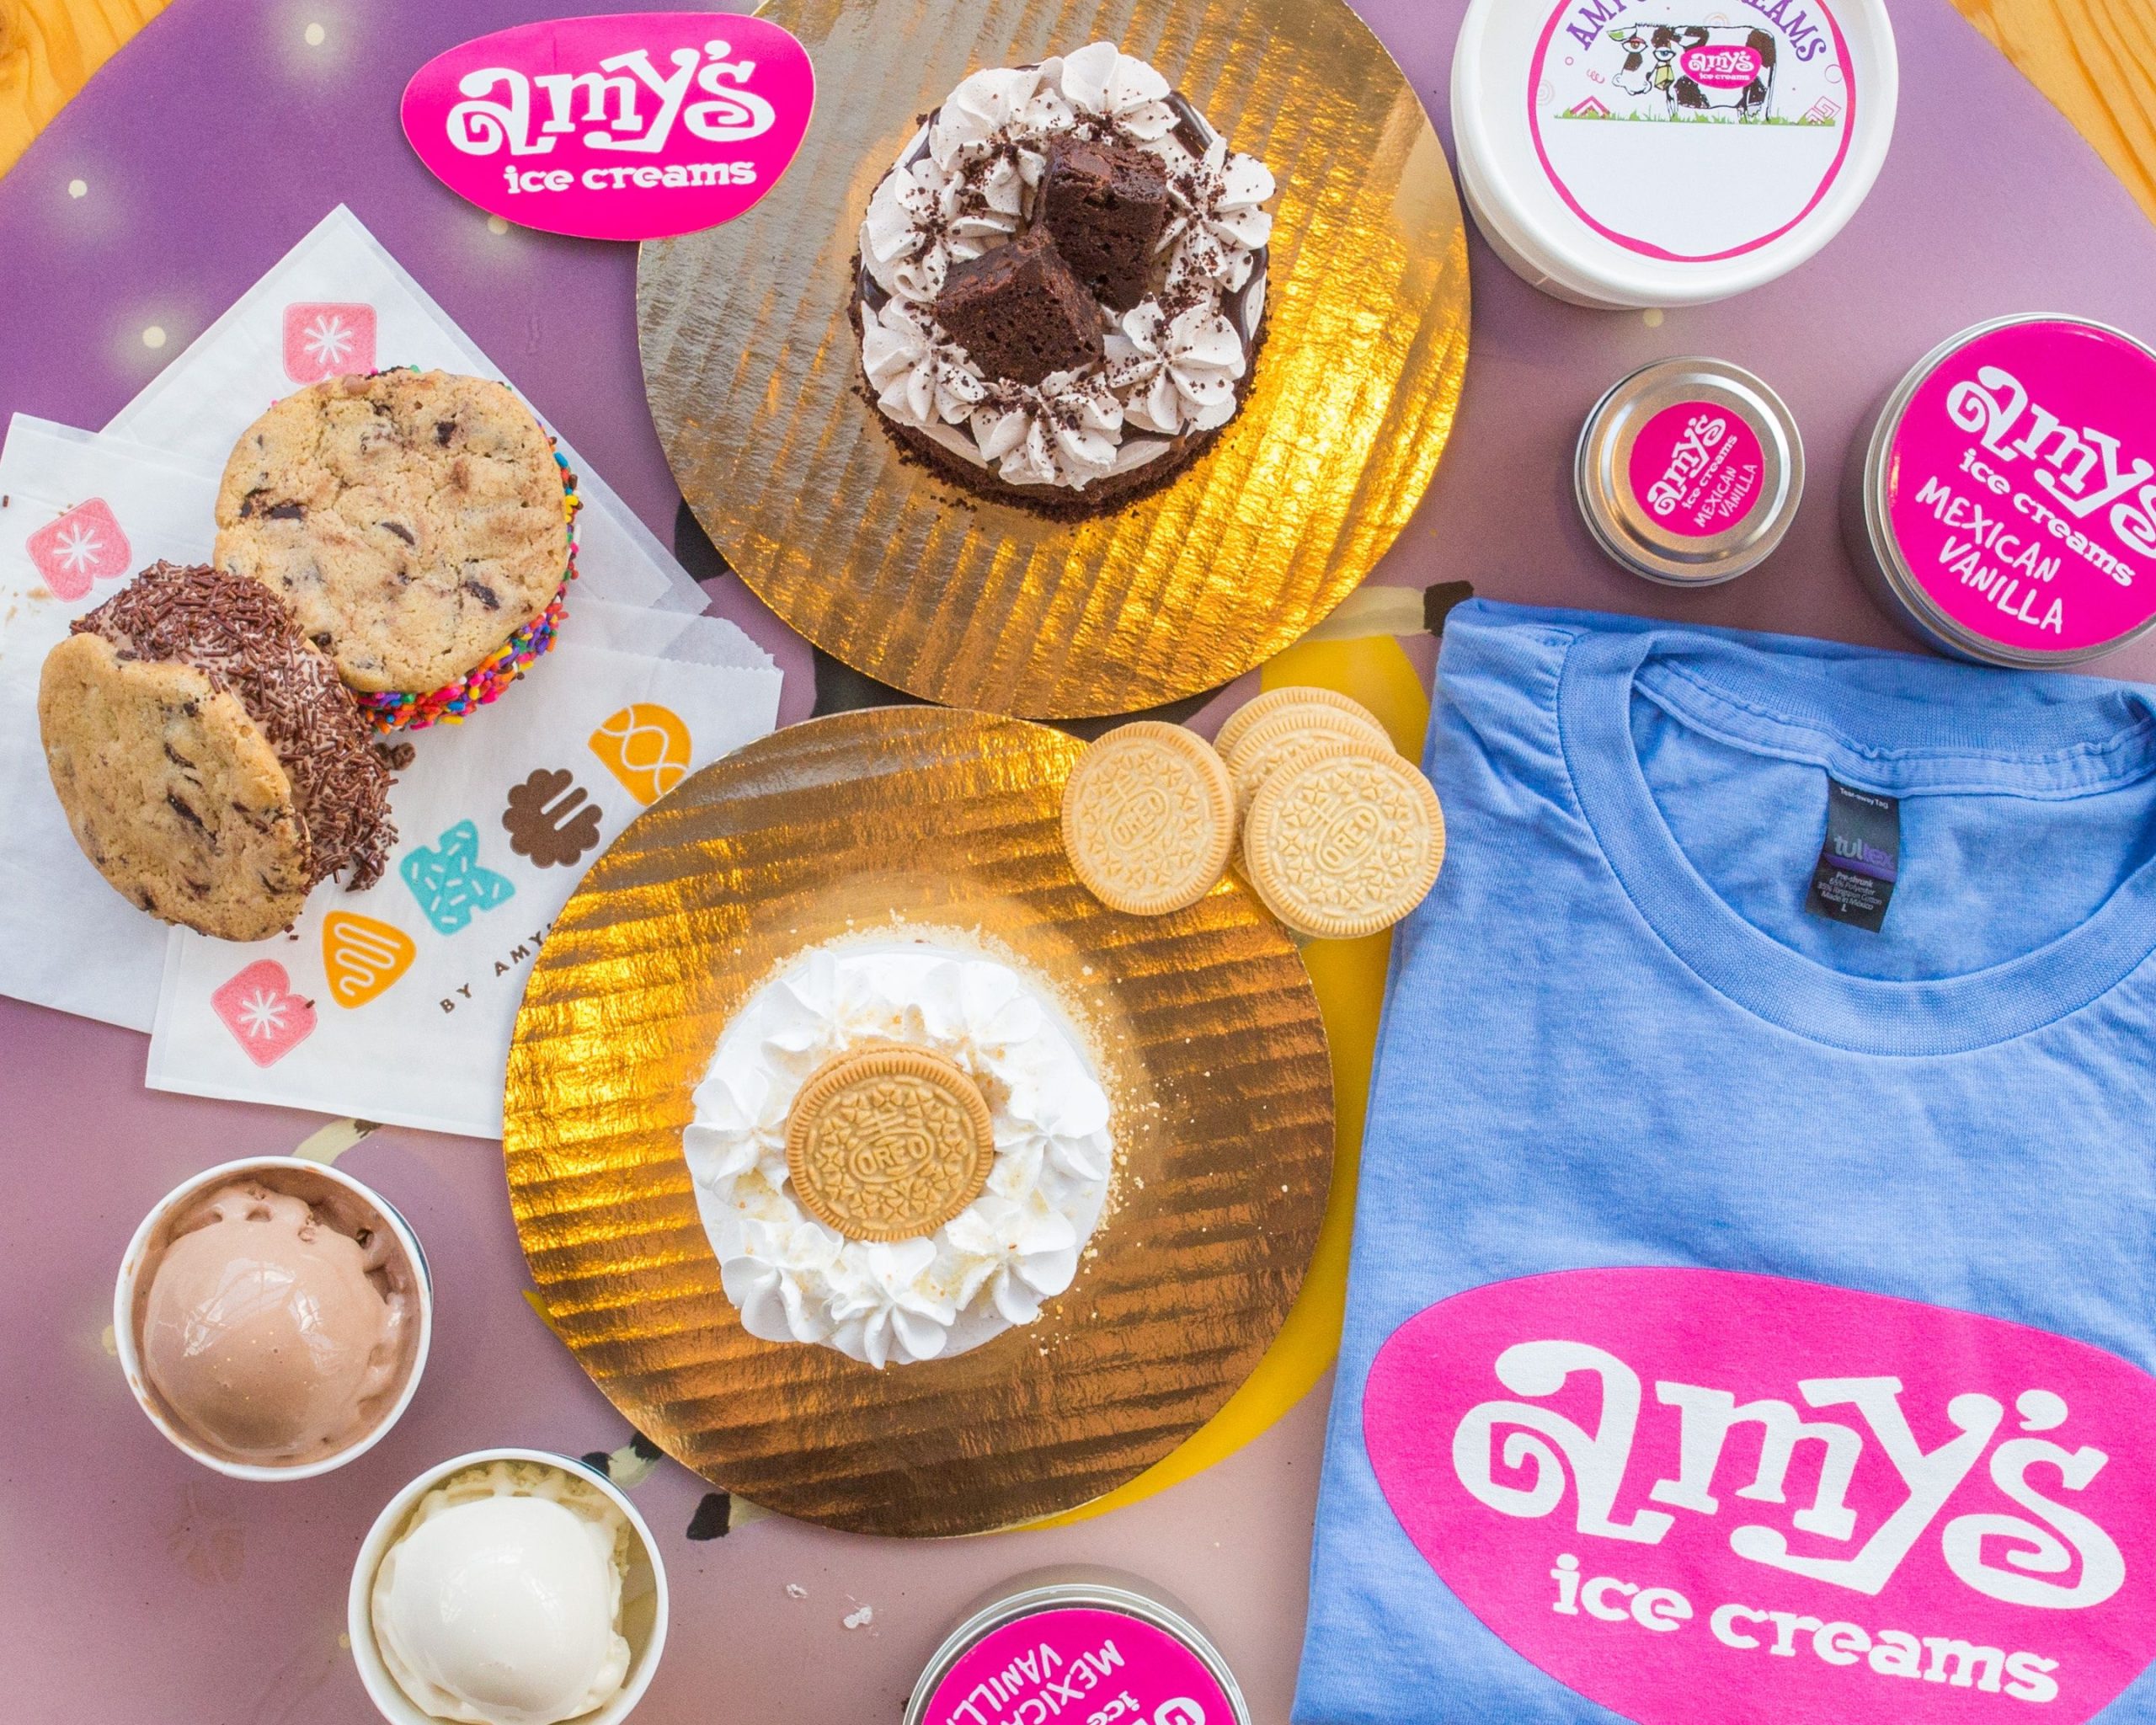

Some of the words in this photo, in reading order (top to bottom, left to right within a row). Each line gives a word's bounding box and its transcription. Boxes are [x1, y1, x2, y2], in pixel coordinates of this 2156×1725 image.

[446, 40, 776, 156] amy's
[1688, 51, 1754, 72] amy's
[504, 165, 574, 195] ice
[582, 161, 757, 190] creams
[1647, 414, 1726, 515] amy's
[1682, 487, 1701, 510] ice
[1700, 435, 1737, 487] creams
[1694, 466, 1737, 527] MEXICAN
[1718, 465, 1758, 517] VANILLA
[1915, 476, 2061, 582] MEXICAN
[1960, 448, 2010, 495] ice
[2013, 493, 2136, 586] creams
[1939, 536, 2063, 634] VANILLA
[1321, 809, 1378, 868] OREO
[1874, 798, 1888, 809] Tag
[439, 982, 472, 1014] BY
[494, 922, 552, 978] AMY'
[856, 1140, 928, 1176] OREO
[1452, 1339, 2126, 1610] amy's
[1550, 1553, 1694, 1632] ice
[1710, 1603, 2060, 1704] creams
[946, 1643, 1063, 1725] VANILL
[1001, 1639, 1125, 1725] MEXIC
